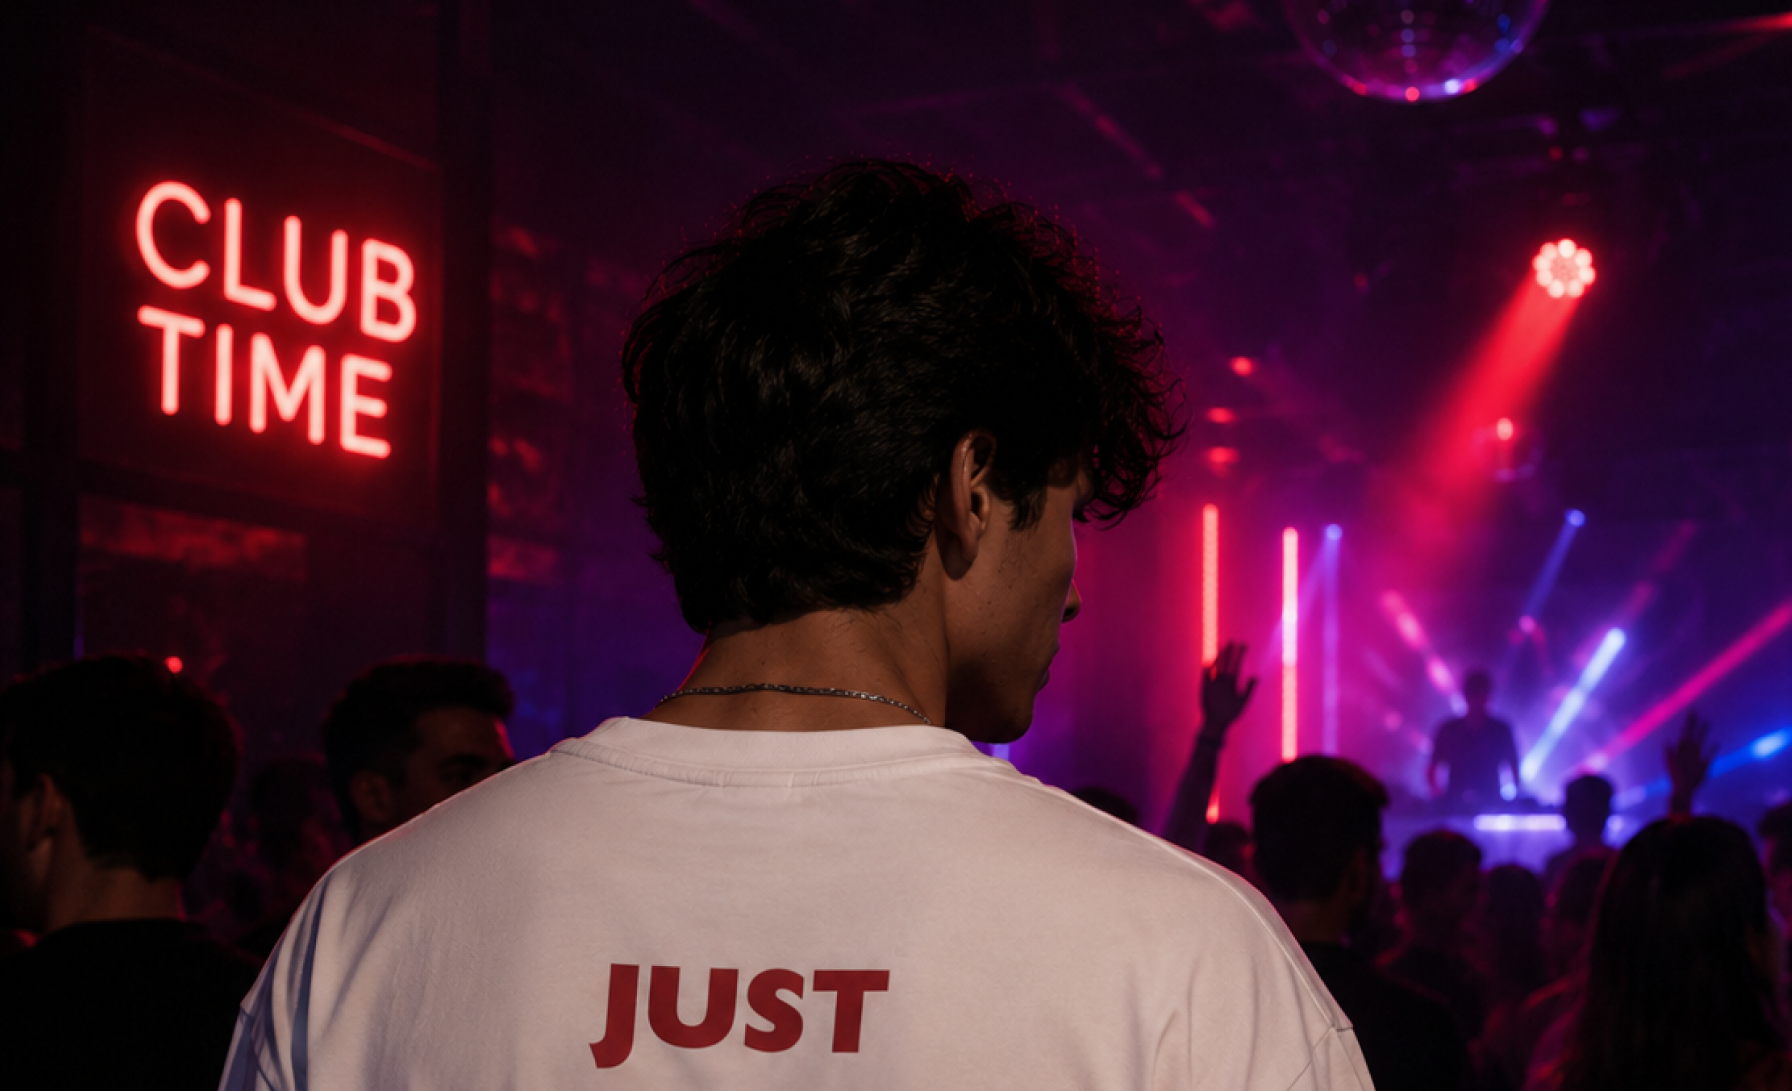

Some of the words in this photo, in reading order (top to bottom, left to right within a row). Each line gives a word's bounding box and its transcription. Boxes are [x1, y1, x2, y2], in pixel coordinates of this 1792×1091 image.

[135, 181, 417, 343] CLUB
[138, 306, 391, 458] TIME
[590, 964, 889, 1068] JUST
